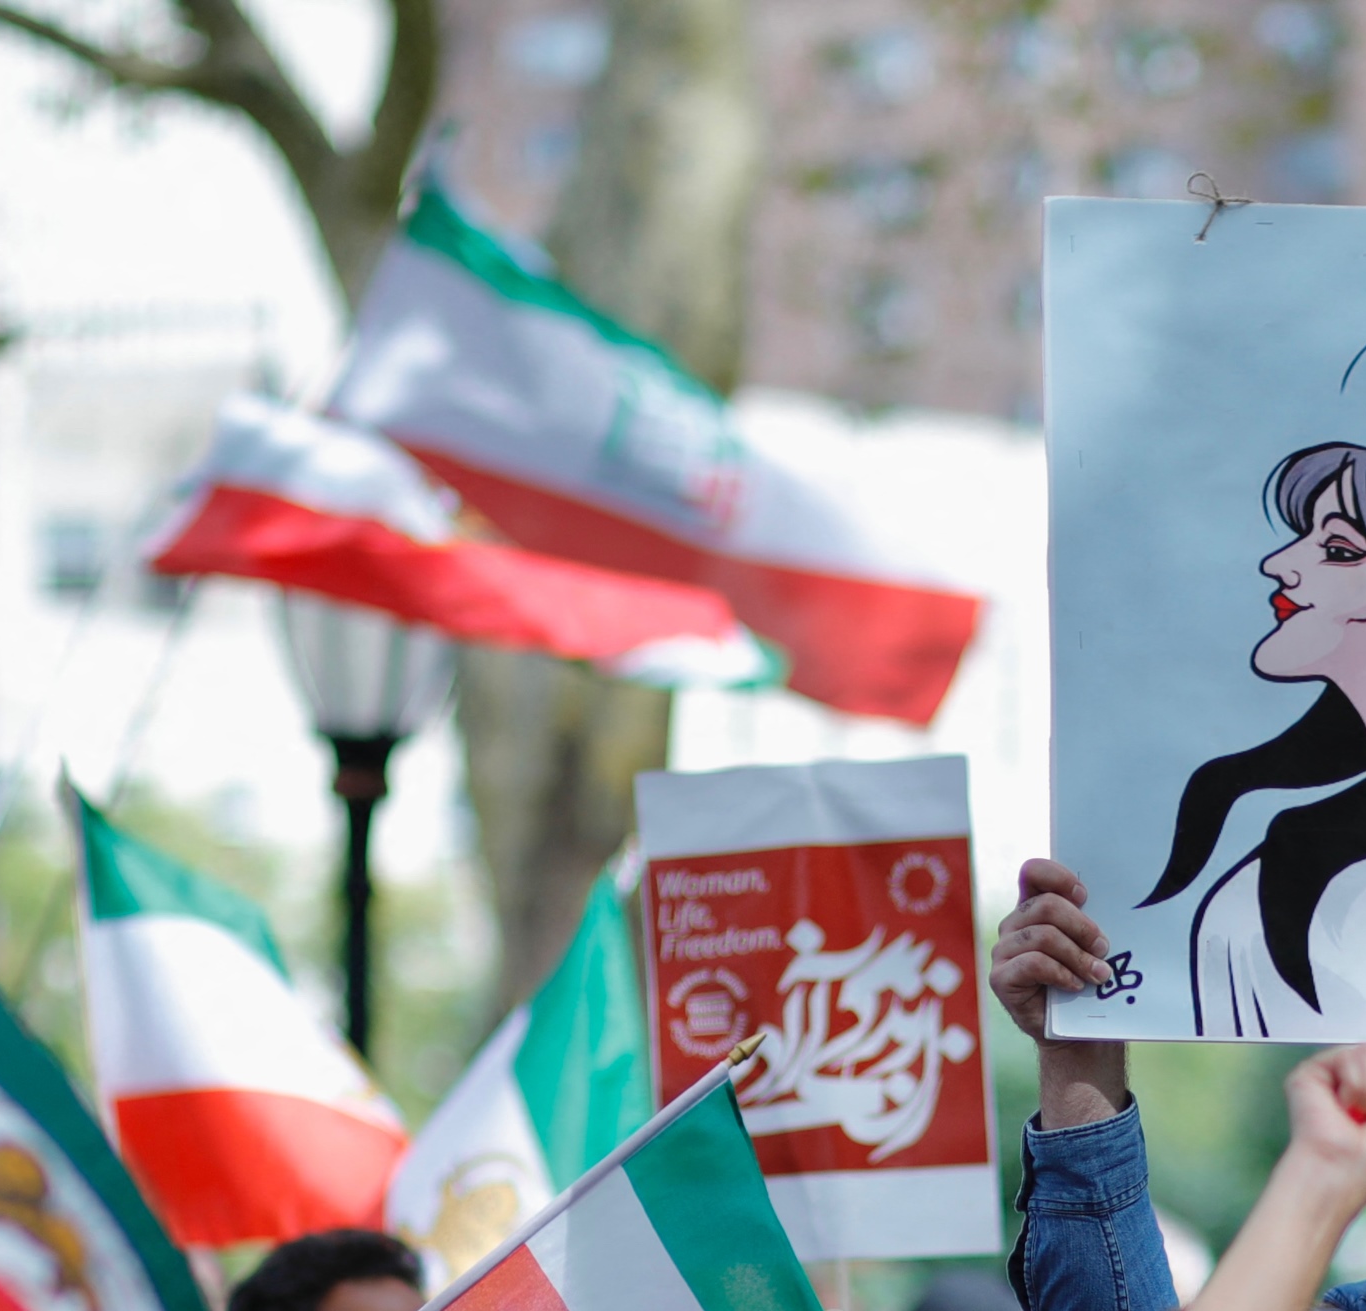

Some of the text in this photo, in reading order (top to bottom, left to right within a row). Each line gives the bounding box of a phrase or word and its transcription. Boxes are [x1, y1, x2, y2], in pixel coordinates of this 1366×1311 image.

[656, 868, 771, 899] Woman.
[658, 900, 717, 936] Life.
[660, 926, 785, 962] Freedom.
